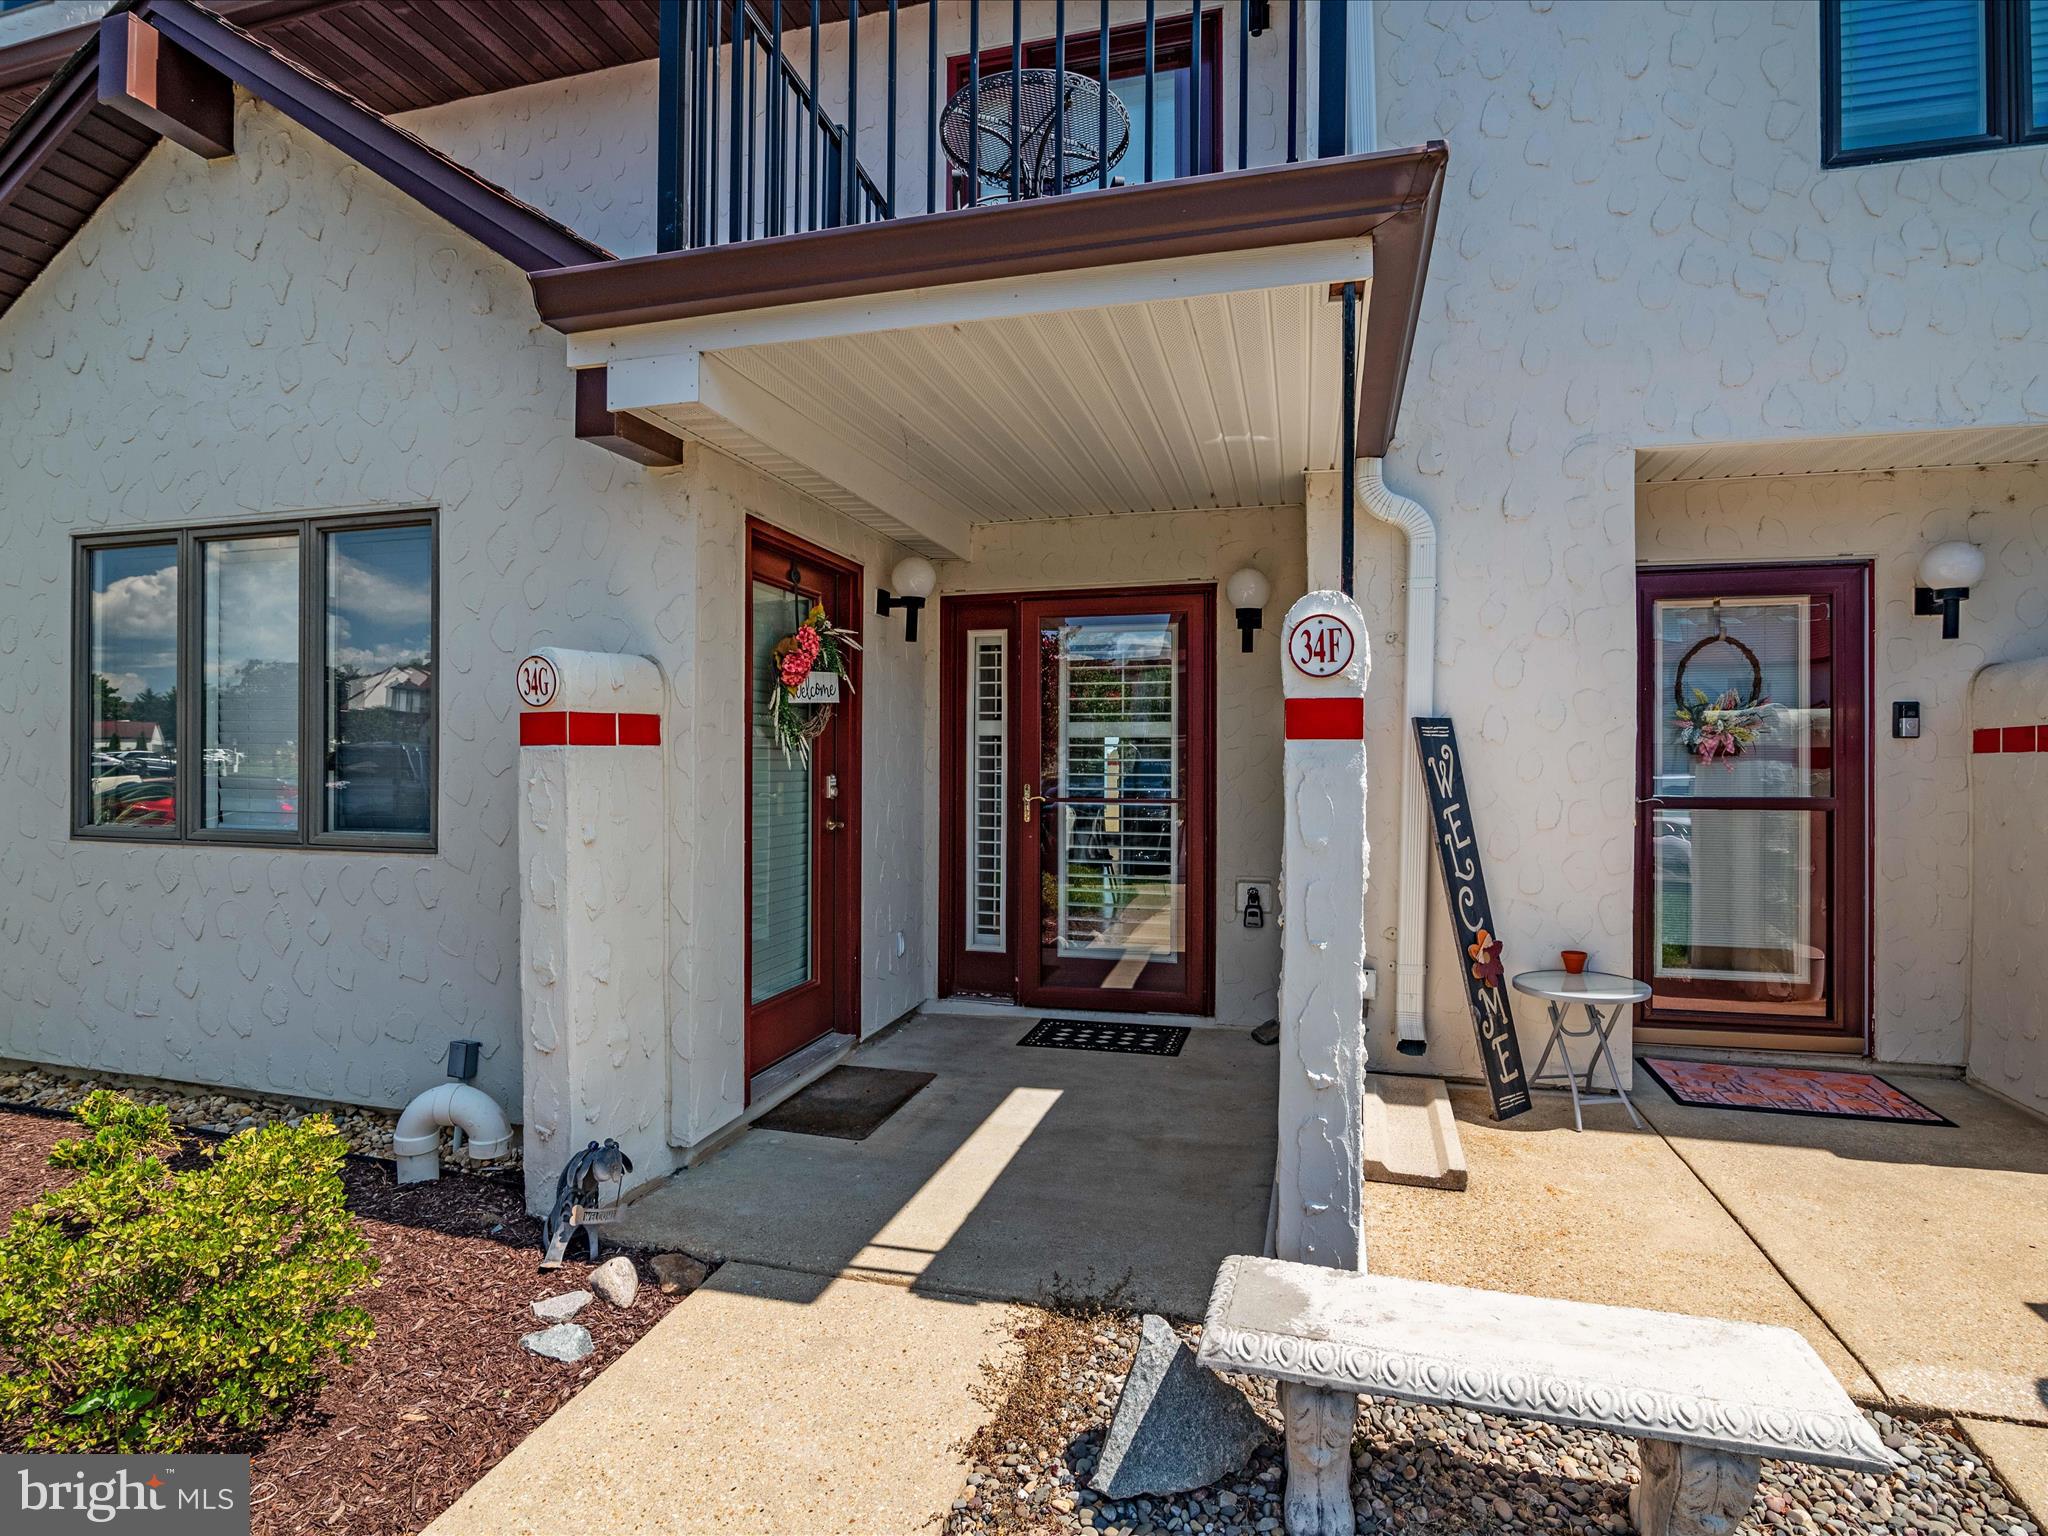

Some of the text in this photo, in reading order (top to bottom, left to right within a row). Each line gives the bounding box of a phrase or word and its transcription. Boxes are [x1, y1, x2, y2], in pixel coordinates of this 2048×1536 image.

[1300, 627, 1343, 664] 34F
[523, 667, 549, 696] 34G
[1428, 744, 1520, 1084] WELCME
